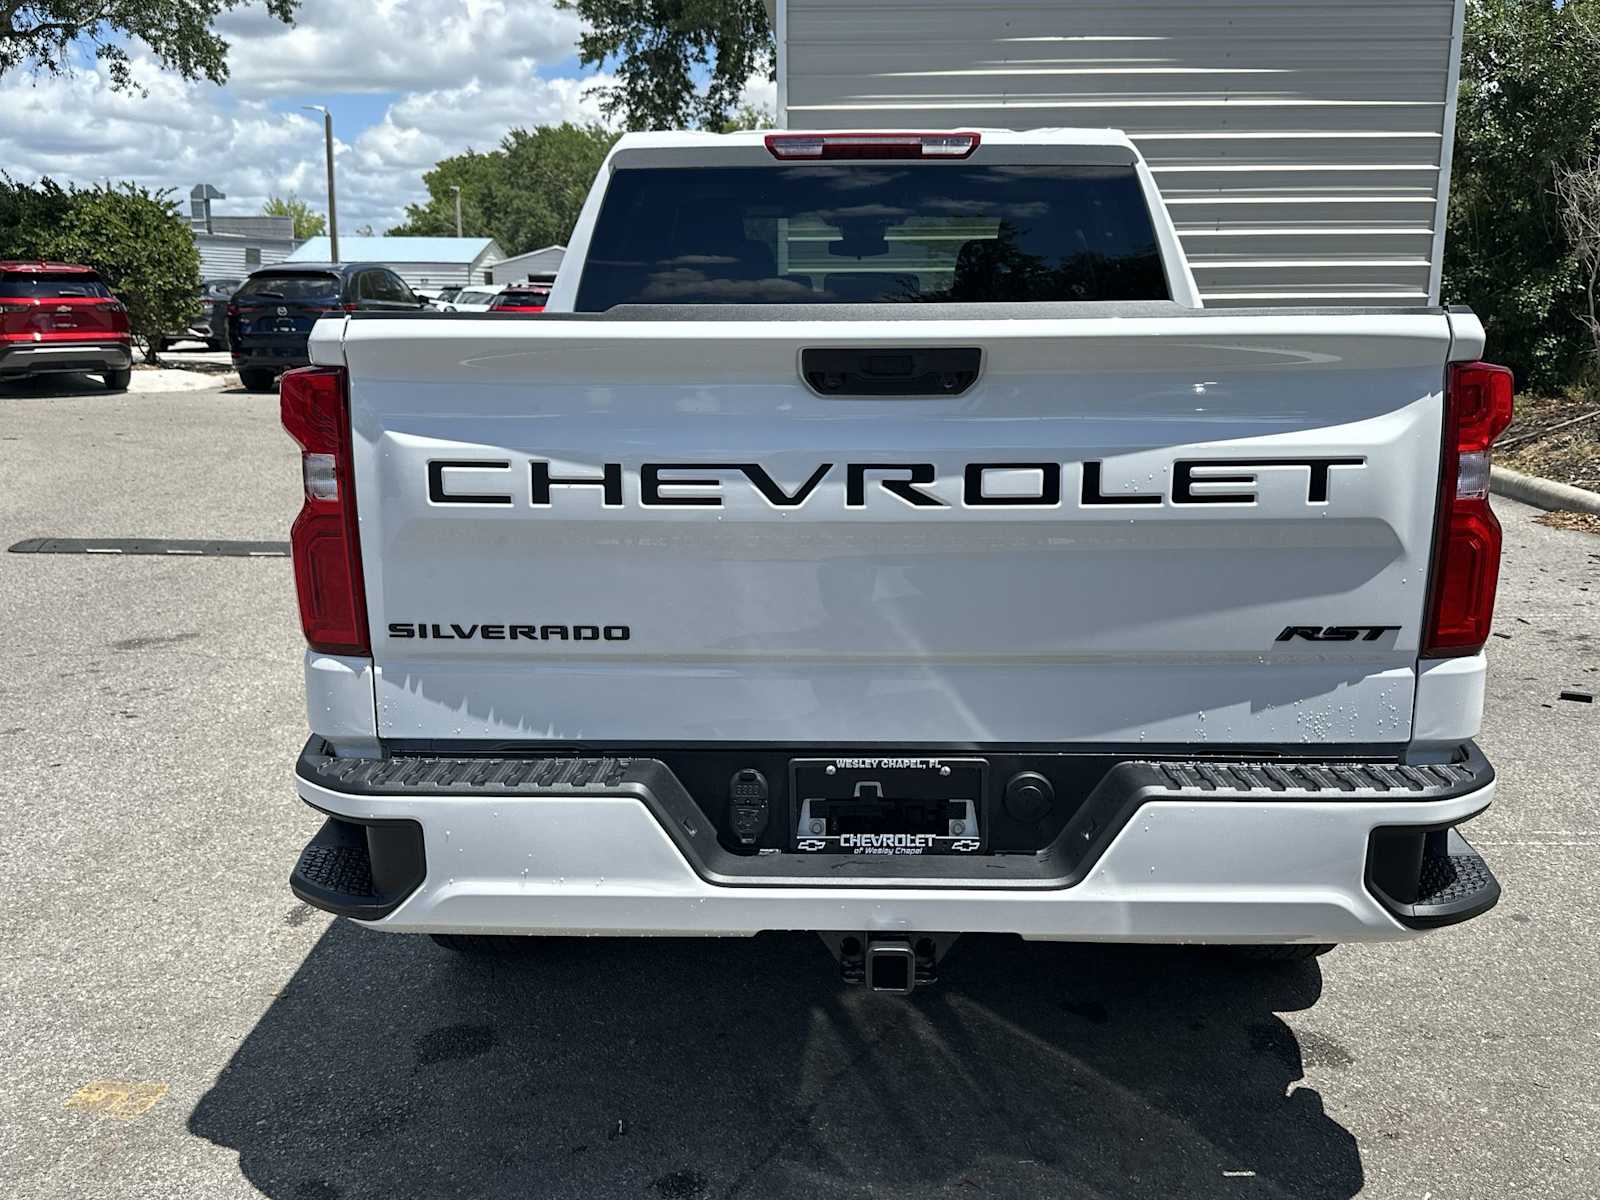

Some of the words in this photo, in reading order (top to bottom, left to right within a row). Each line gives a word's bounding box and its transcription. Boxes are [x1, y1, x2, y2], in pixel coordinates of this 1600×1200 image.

[428, 457, 1366, 507] CHEVROLET
[388, 623, 631, 641] SILVERADO
[1274, 625, 1402, 641] RST
[836, 758, 879, 769] WESLEY
[880, 758, 927, 770] CHAPEL,
[928, 758, 942, 769] FL
[840, 833, 937, 847] CHEVROLET
[853, 847, 864, 855] of
[864, 847, 894, 856] Wesley
[894, 847, 923, 856] Chapel
